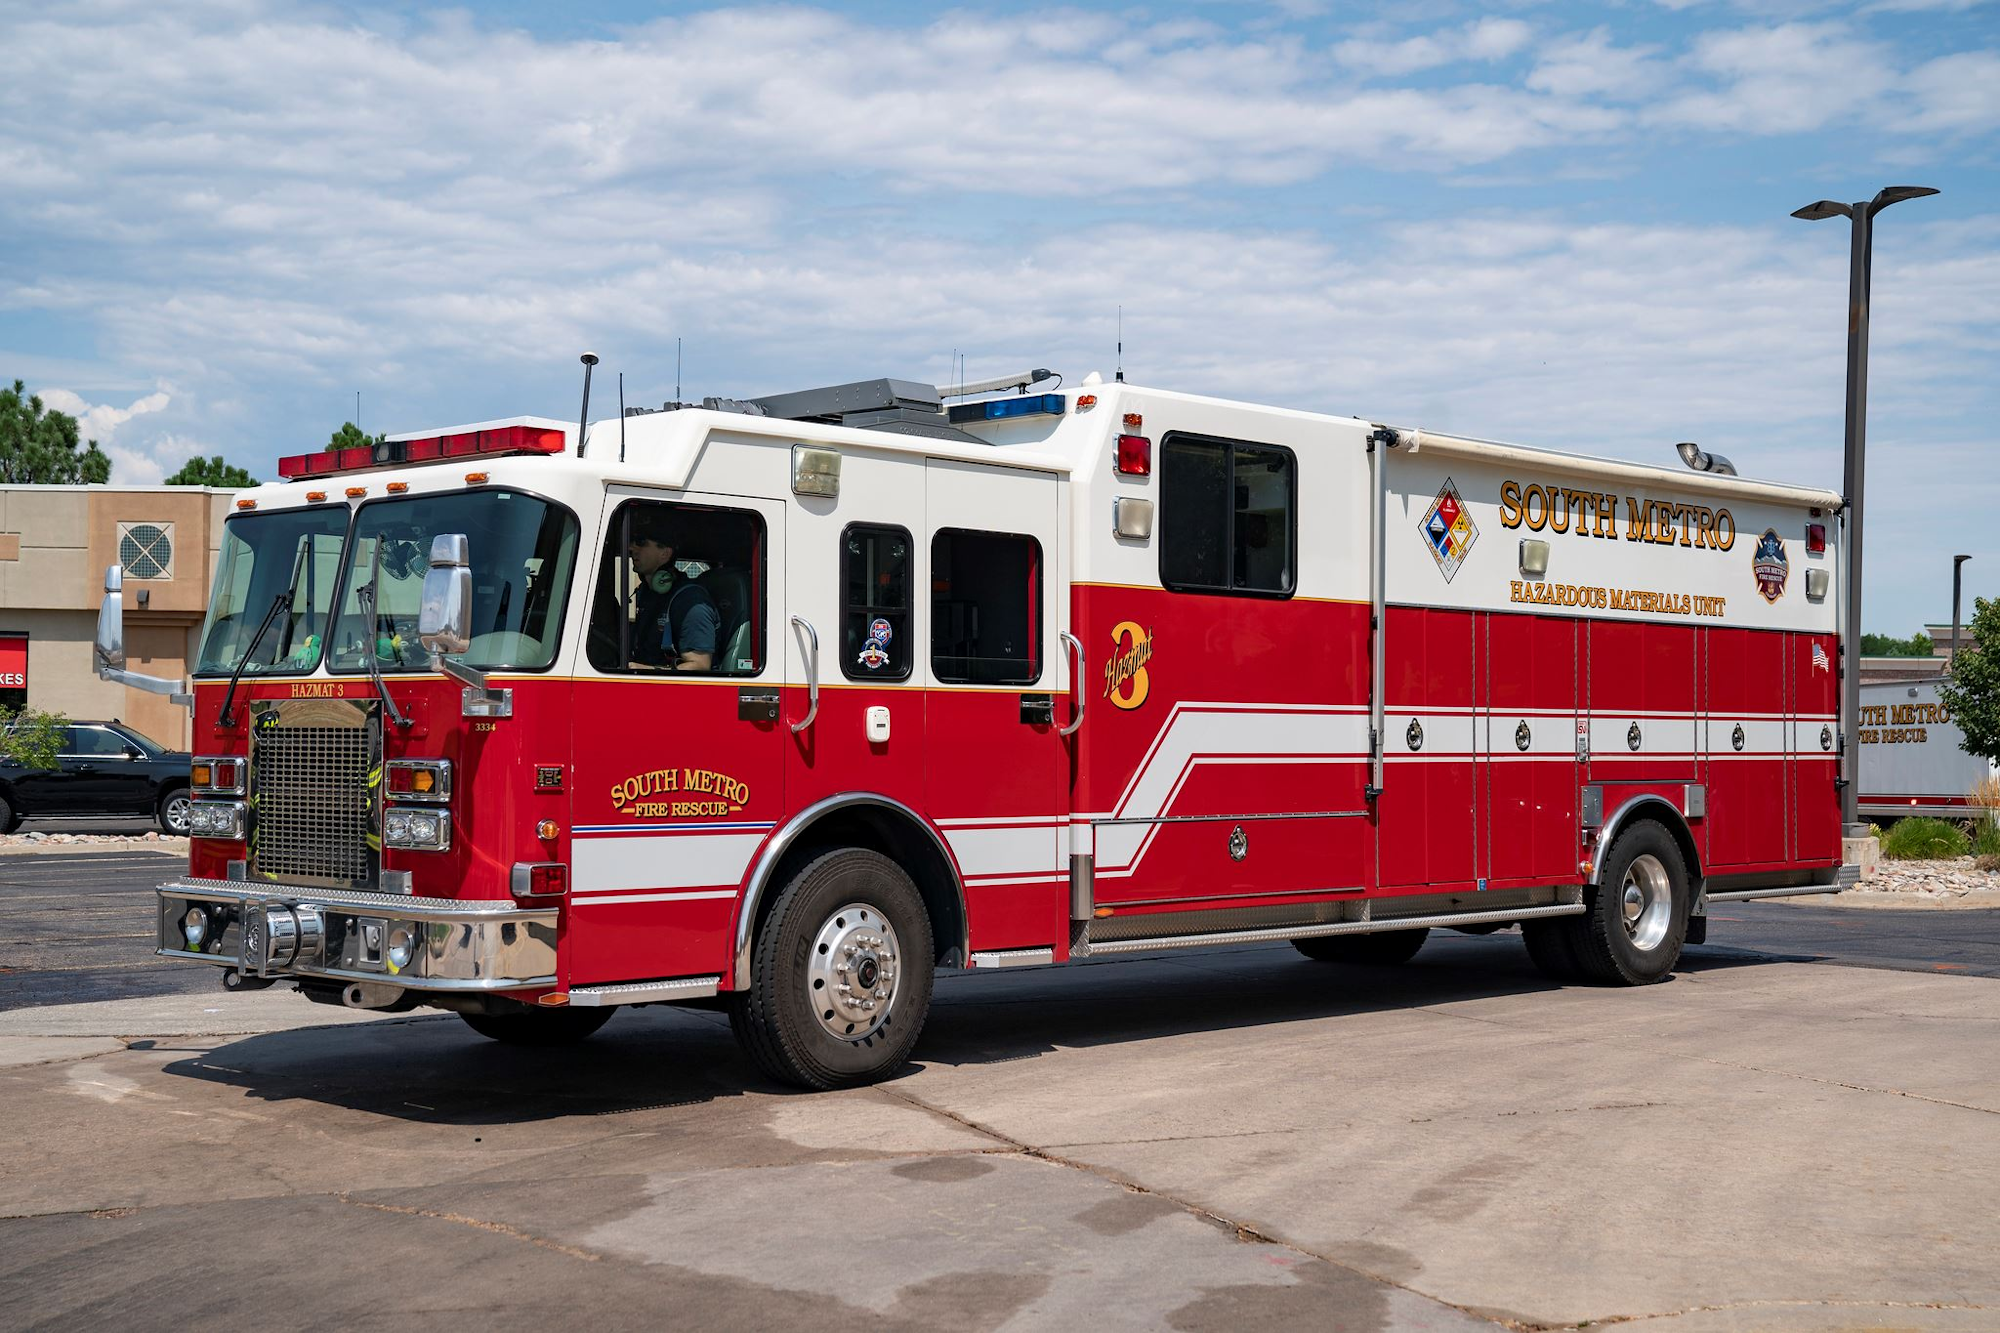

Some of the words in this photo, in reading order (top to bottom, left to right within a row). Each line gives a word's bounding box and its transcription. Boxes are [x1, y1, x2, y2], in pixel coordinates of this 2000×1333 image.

[1500, 481, 1617, 540] SOUTH
[1626, 497, 1736, 552] METRO
[1510, 580, 1607, 609] HAZARDOUS
[1609, 588, 1691, 614] MATERIALS
[1693, 595, 1726, 617] UNIT
[1103, 626, 1153, 698] Hazmat
[1110, 621, 1149, 711] 3
[291, 684, 334, 698] HAZMAT
[337, 684, 344, 697] 3
[475, 723, 496, 732] 3334
[1891, 703, 1951, 725] METRO
[1881, 728, 1927, 744] RESCUE
[610, 768, 679, 809] SOUTH
[683, 768, 750, 806] METRO
[635, 803, 668, 817] FIRE
[671, 802, 729, 817] RESCUE
